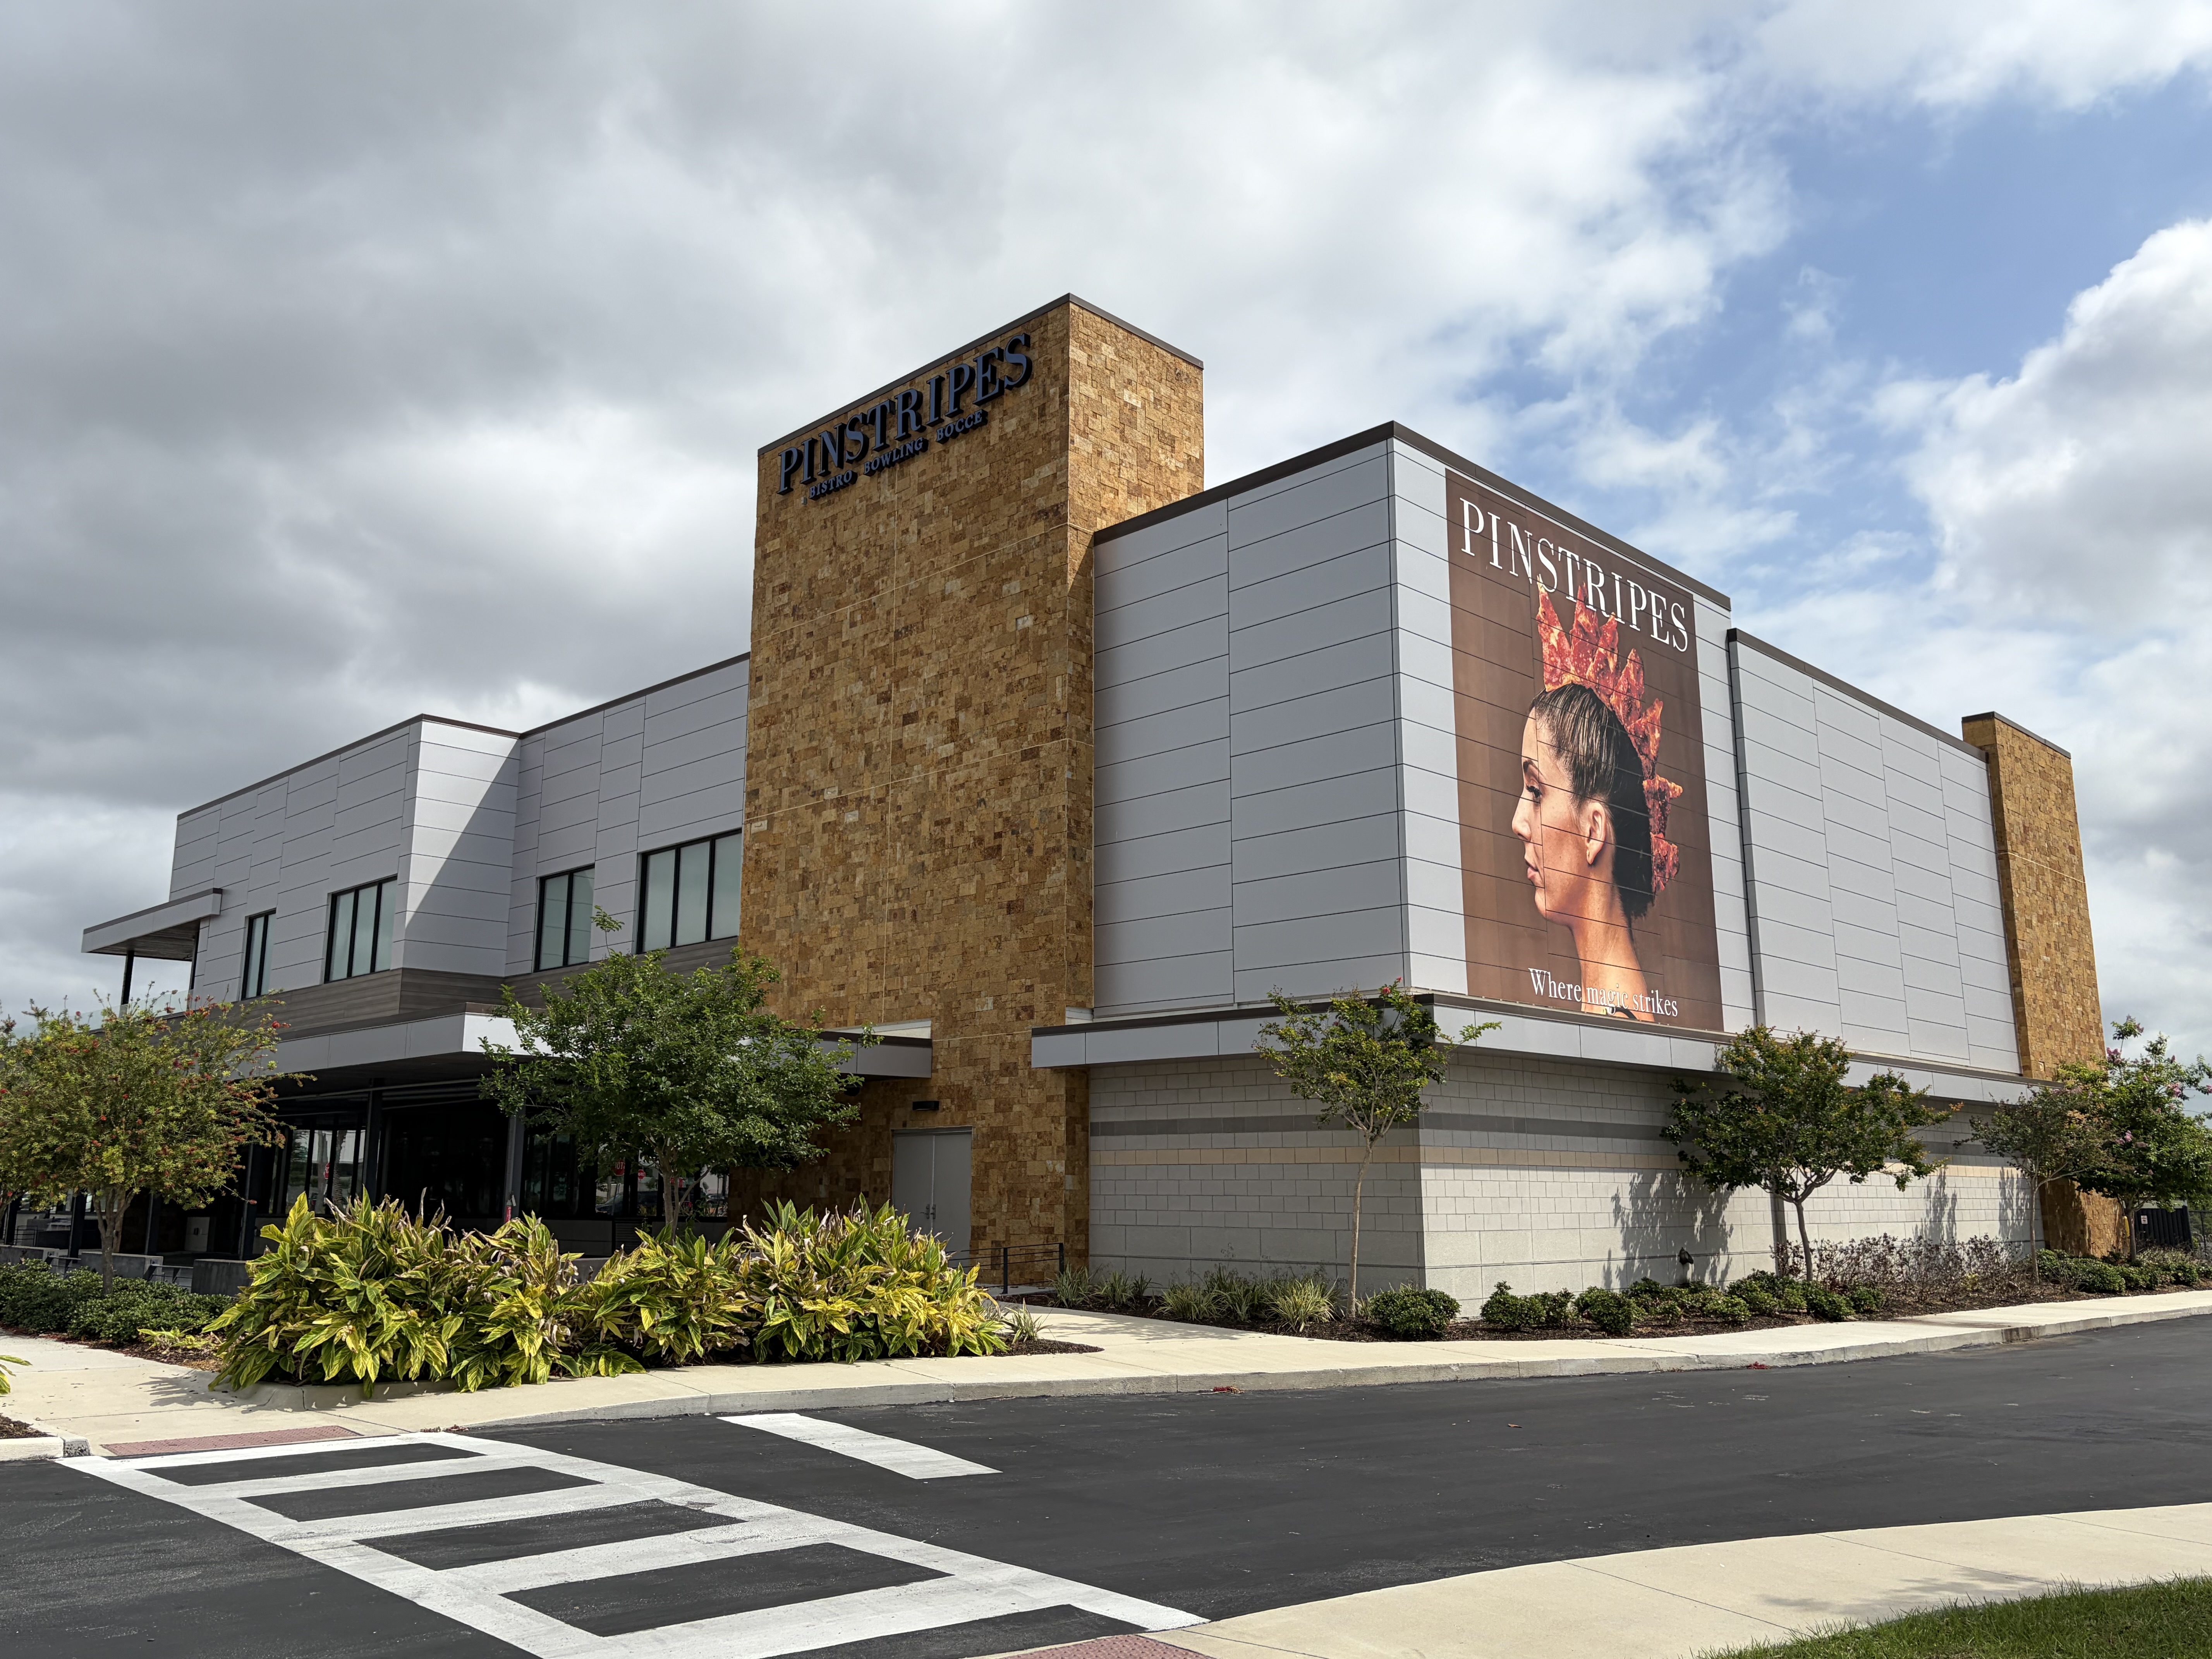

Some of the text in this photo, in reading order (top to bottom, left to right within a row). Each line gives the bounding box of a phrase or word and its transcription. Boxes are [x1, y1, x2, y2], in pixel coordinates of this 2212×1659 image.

[777, 333, 1032, 495] PINSTRIPES
[809, 409, 988, 500] BISTRO BOWLING BOCCE
[1460, 497, 1688, 652] PINSTRIPES
[1528, 968, 1678, 1017] Where magic strikes
